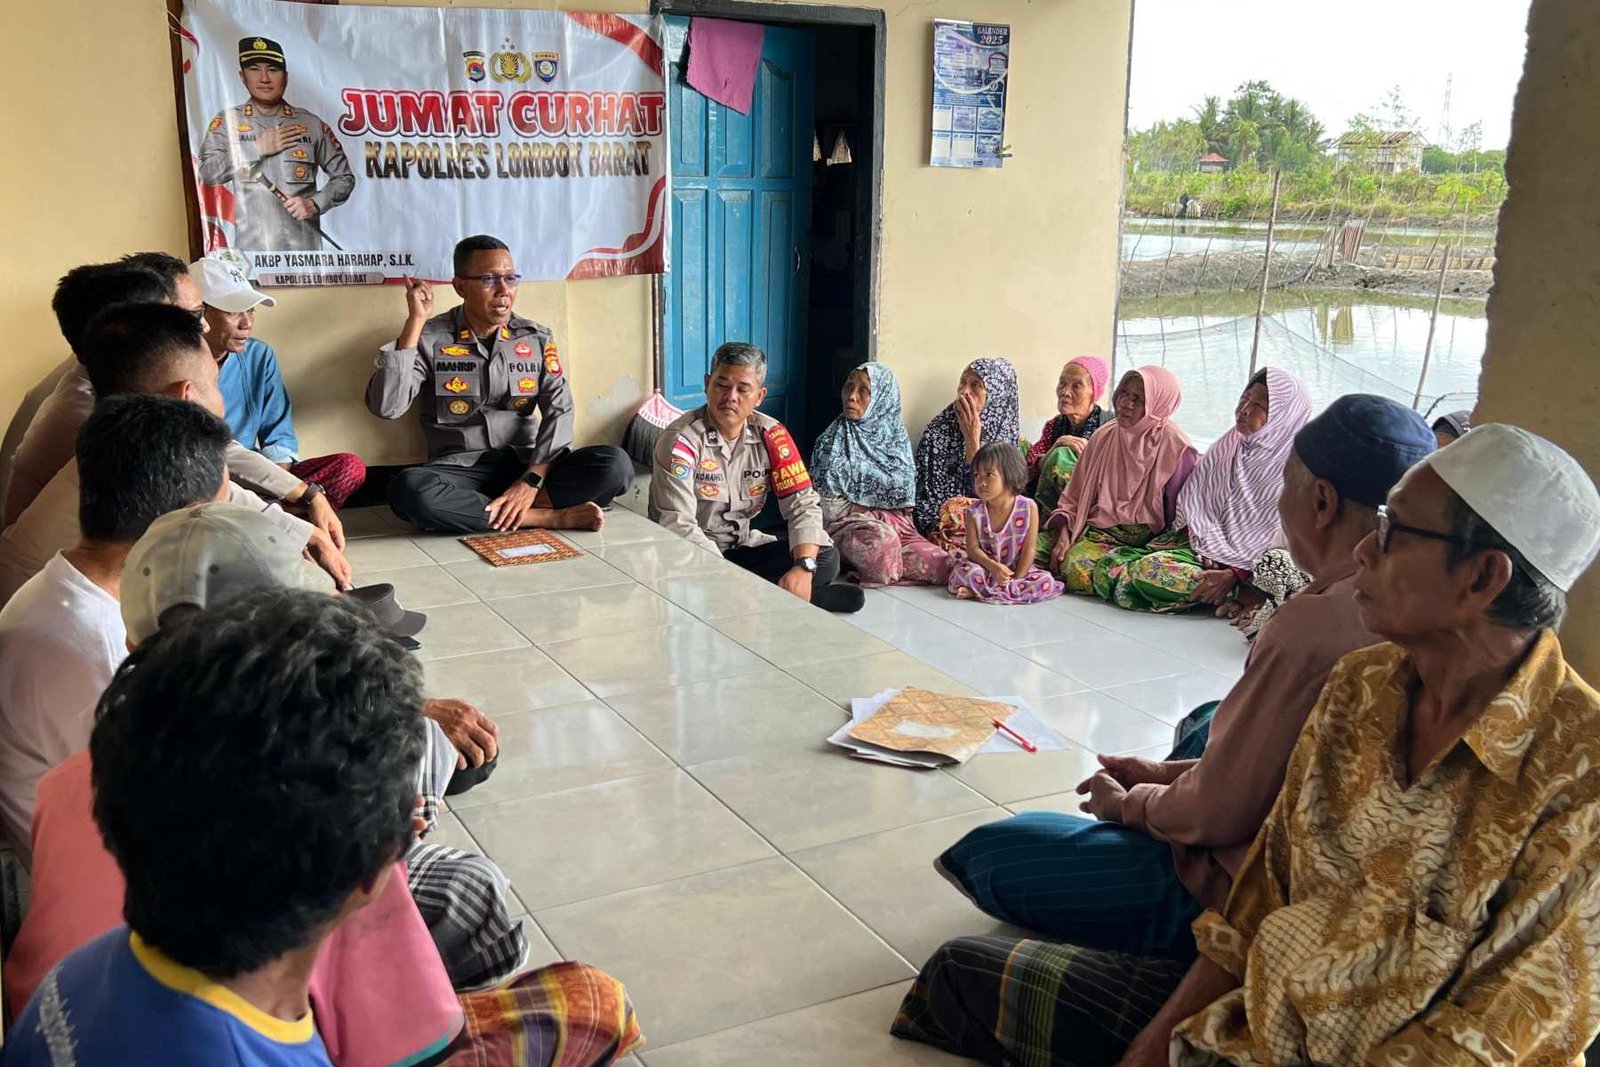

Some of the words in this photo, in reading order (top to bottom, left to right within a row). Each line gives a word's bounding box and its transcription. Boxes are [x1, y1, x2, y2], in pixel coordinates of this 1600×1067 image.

[980, 35, 1004, 45] 2025
[338, 88, 504, 138] JUMAT
[507, 90, 666, 138] CURHAT
[365, 141, 490, 179] KAPOLRES
[495, 141, 583, 179] LOMBOK
[589, 141, 651, 178] BARAT
[254, 254, 281, 268] AKBP
[285, 254, 334, 268] YASMARA
[337, 253, 387, 268] HARAHAP,
[389, 254, 414, 266] S.I.K.
[509, 362, 540, 373] POLRI
